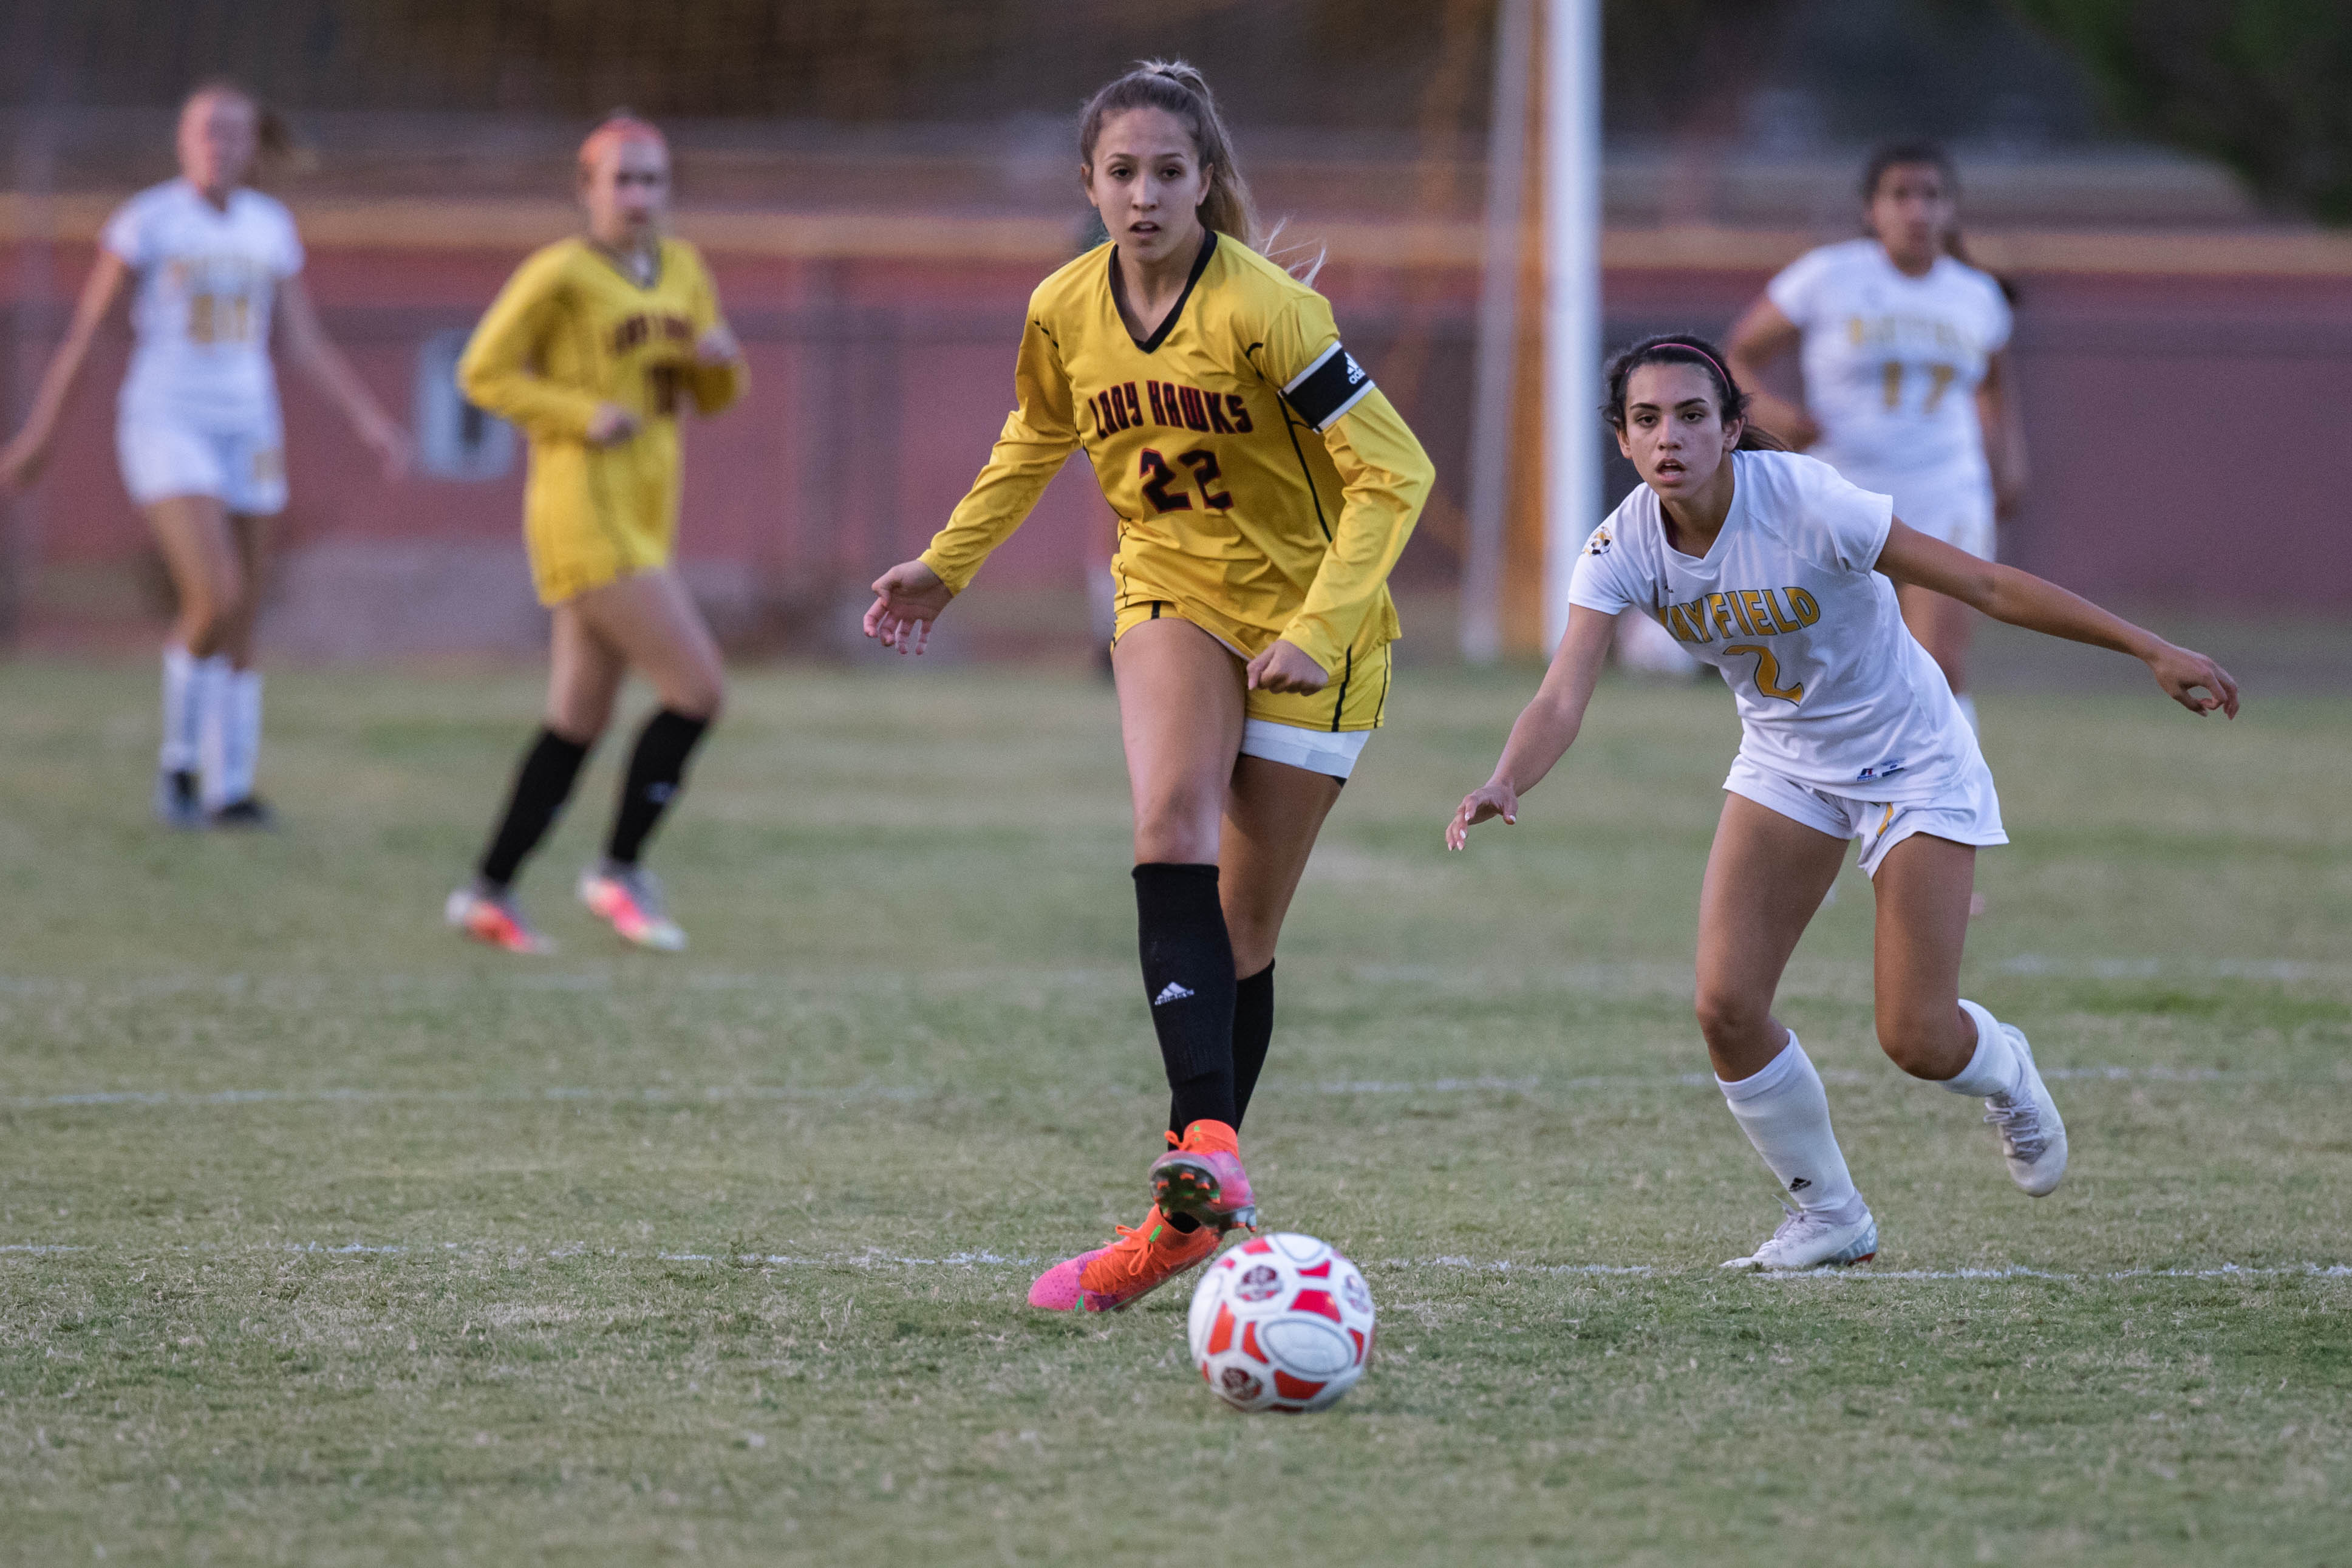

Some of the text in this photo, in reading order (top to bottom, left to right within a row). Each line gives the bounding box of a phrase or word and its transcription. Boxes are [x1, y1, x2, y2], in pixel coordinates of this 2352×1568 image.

[1088, 380, 1253, 440] LADY HAWKS
[1139, 448, 1234, 514] 22
[1722, 644, 1805, 707] 2
